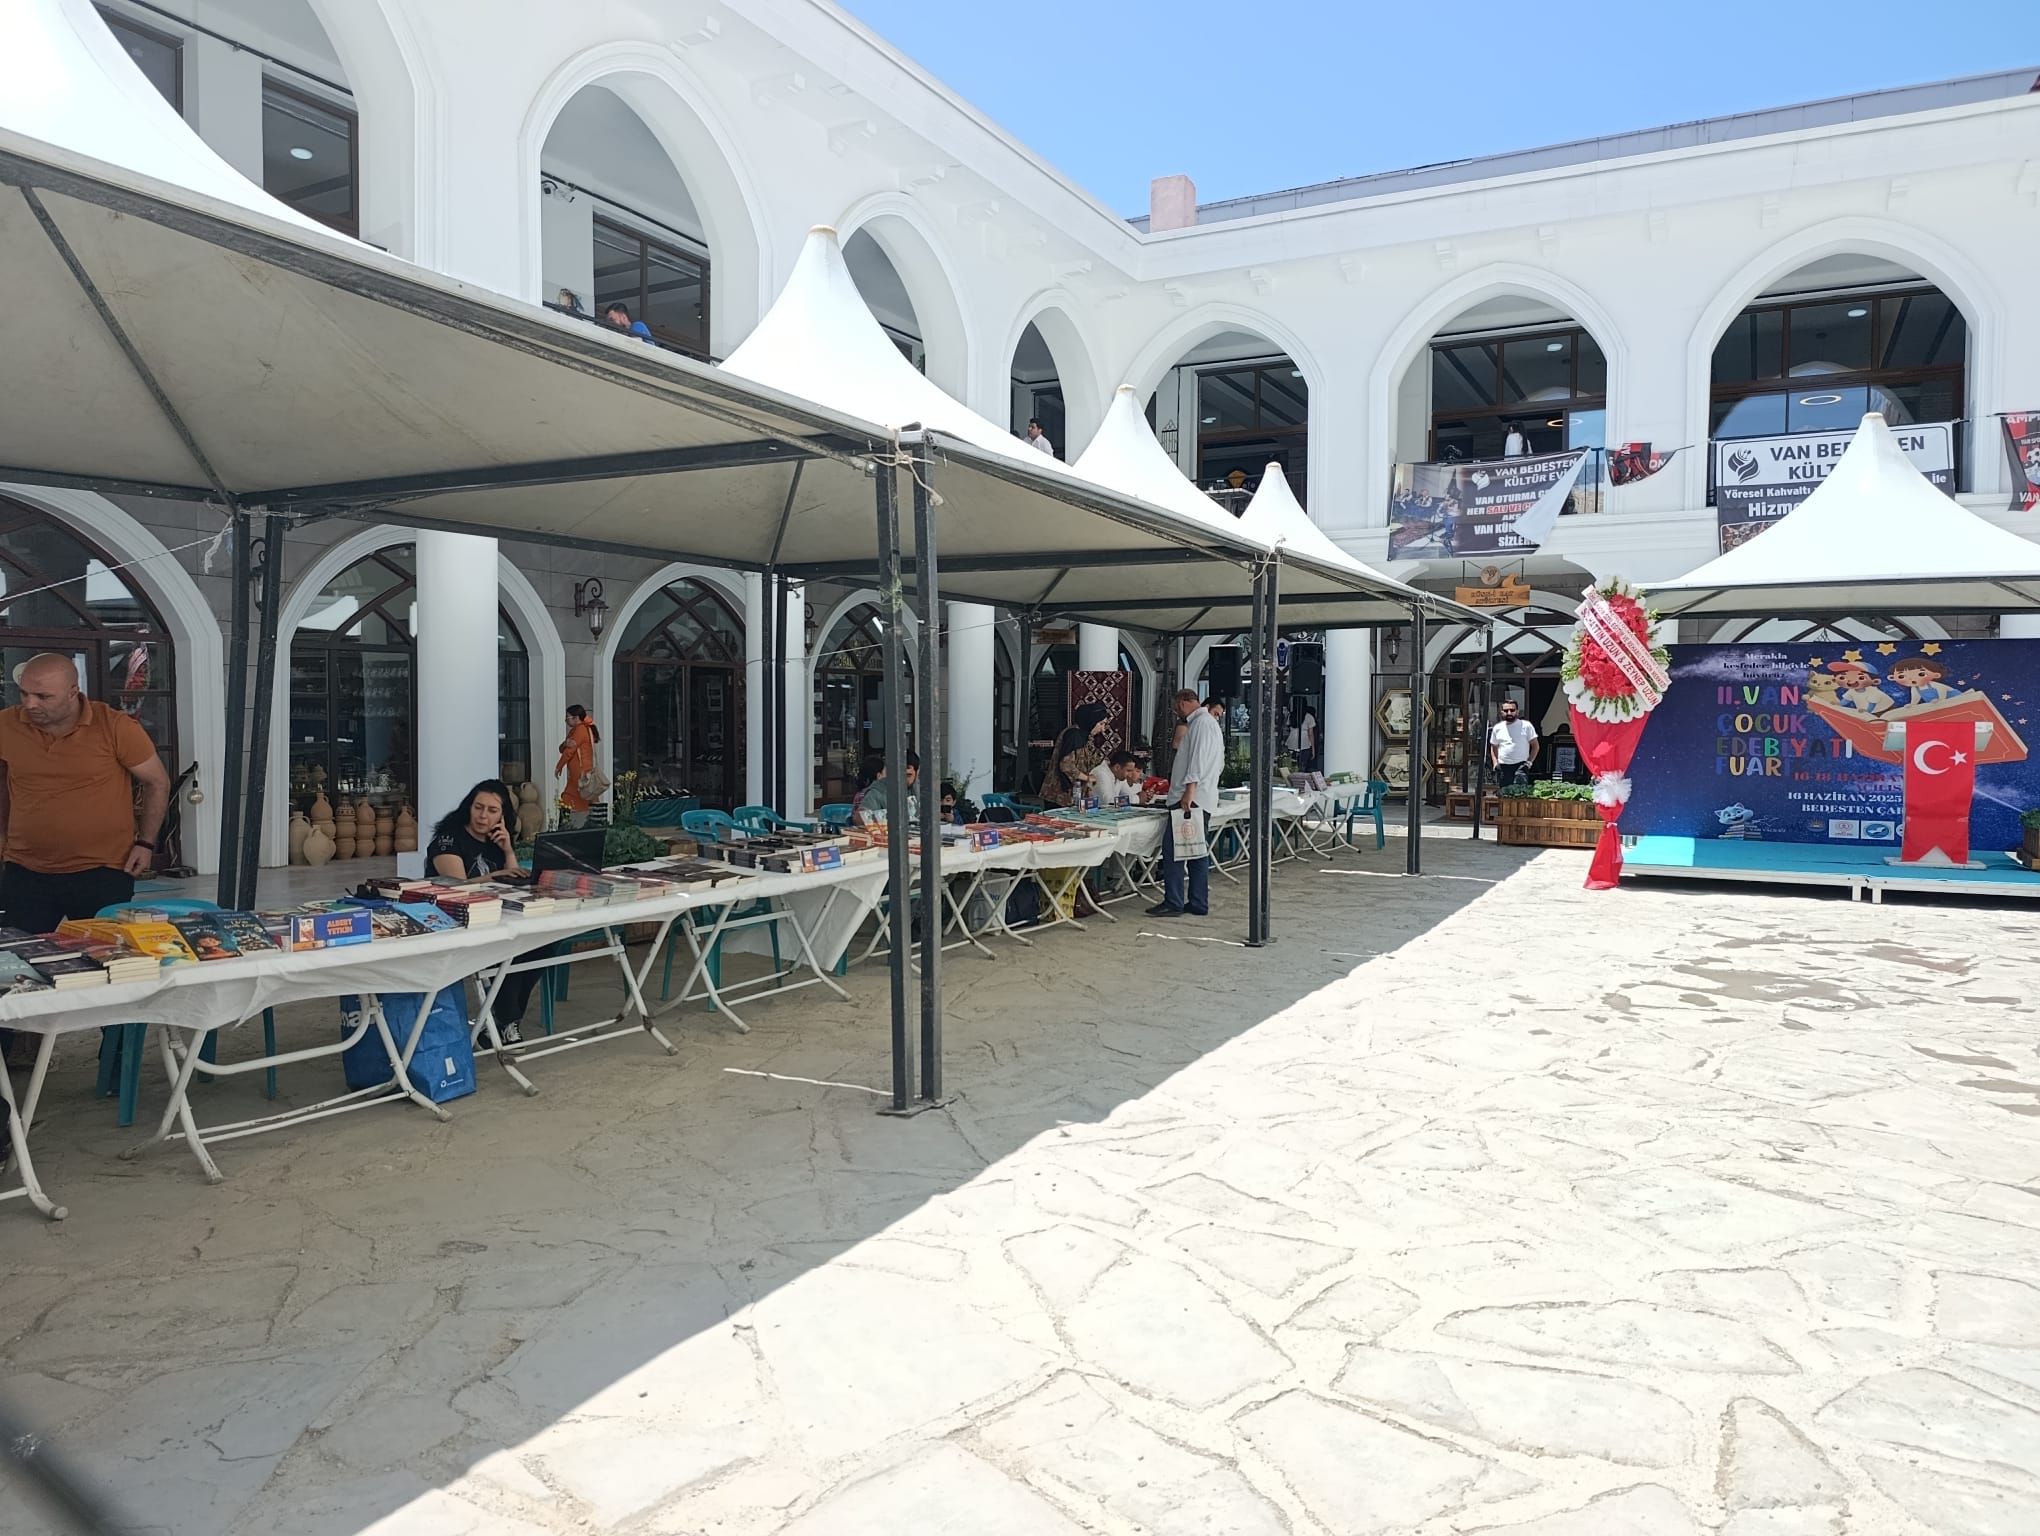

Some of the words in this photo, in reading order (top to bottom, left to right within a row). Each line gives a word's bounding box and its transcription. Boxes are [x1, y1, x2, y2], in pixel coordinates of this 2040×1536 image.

[1770, 445, 1810, 461] VAN
[1496, 467, 1517, 476] VAN
[1519, 458, 1577, 475] BEDESTEN
[1789, 461, 1836, 480] KÜLT
[1504, 473, 1547, 487] KÜLTÜR
[1475, 496, 1494, 505] VAN
[1496, 491, 1537, 504] OTURMA
[1724, 488, 1764, 499] Yöresel
[1766, 486, 1811, 497] Kahvaltı
[1466, 507, 1485, 515] HER
[1486, 505, 1508, 514] SALI
[1509, 503, 1522, 512] VE
[1748, 502, 1799, 517] Hizm
[1474, 524, 1493, 535] VAN
[1602, 637, 1621, 658] UZUN
[1623, 661, 1646, 687] ZEYNEP
[1642, 687, 1659, 705] UZUN
[1717, 713, 1808, 736] ÇOCUK
[1715, 757, 1792, 776] FUARI
[1804, 791, 1866, 802] HAZİRAN
[1868, 794, 1902, 803] 2025
[1801, 804, 1874, 815] BEDESTEN
